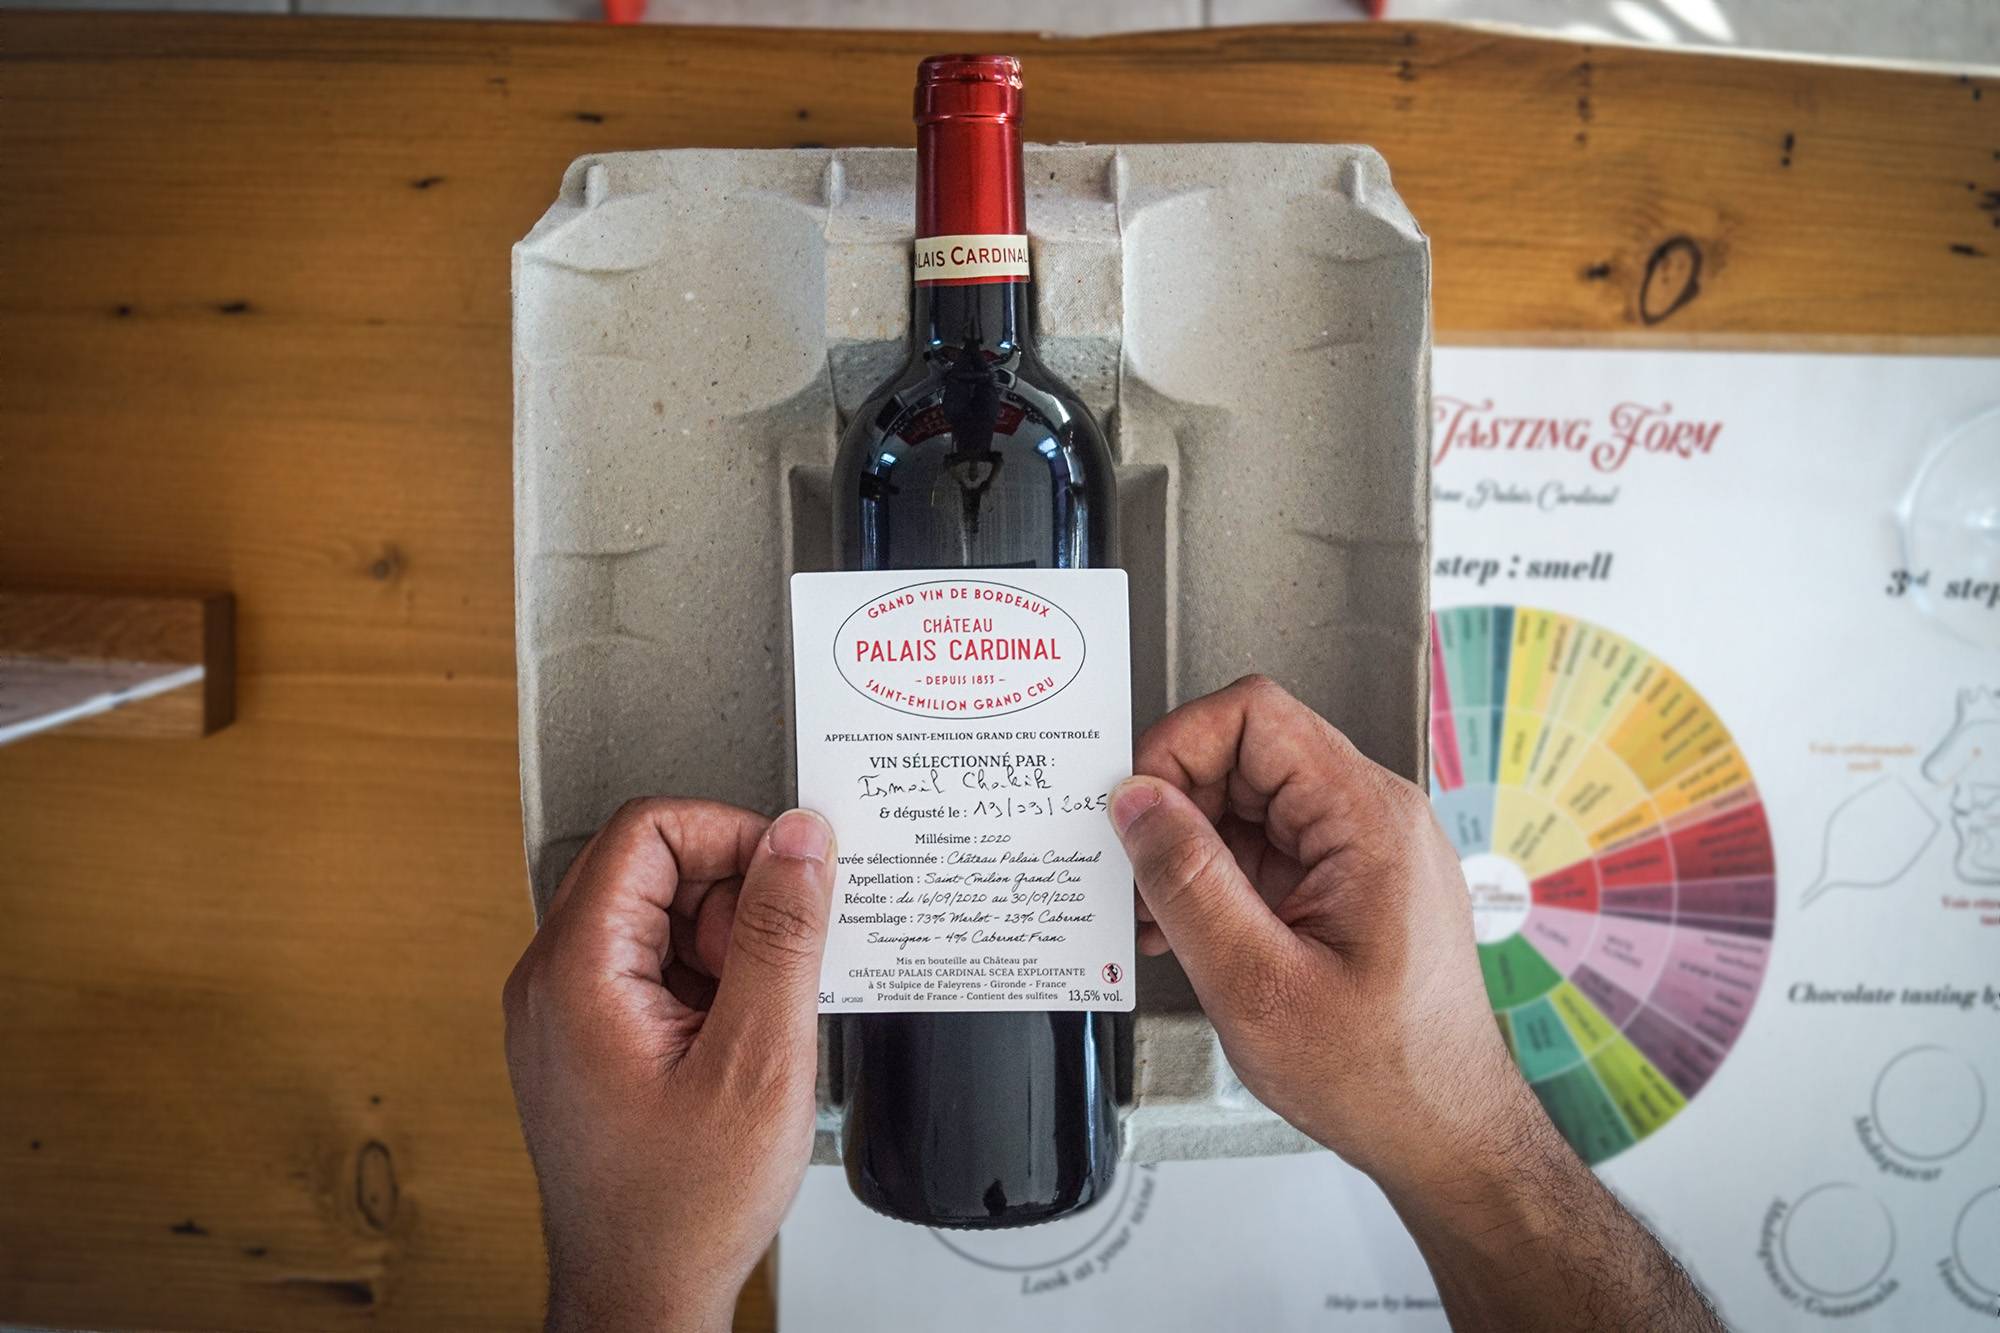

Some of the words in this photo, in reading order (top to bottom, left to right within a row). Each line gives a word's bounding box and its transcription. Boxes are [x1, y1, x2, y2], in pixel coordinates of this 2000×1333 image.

[1434, 554, 1500, 586] step
[1526, 552, 1614, 580] smell
[868, 594, 914, 617] GRAND
[920, 590, 942, 600] VIN
[951, 588, 967, 599] DE
[975, 587, 1052, 619] BORDEAUX
[924, 616, 992, 633] CHÂTEAU
[857, 640, 936, 662] PALAIS
[950, 639, 1061, 660] CARDINAL
[926, 676, 966, 685] DEPUIS
[972, 675, 994, 684] 1853
[865, 679, 966, 711] SAINT-EMILION
[974, 693, 1023, 712] GRAND
[1028, 678, 1055, 698] CRU
[976, 732, 1013, 740] GRAND
[1016, 731, 1035, 740] CRU
[1038, 728, 1100, 739] CONTROLÉE
[870, 757, 897, 768] VIN
[903, 752, 1012, 769] SÉLECTIONNÉ
[1016, 755, 1047, 767] PAR
[880, 807, 890, 818] &
[894, 806, 944, 821] dégusté
[949, 807, 959, 817] le
[915, 833, 970, 844] Millésime
[980, 835, 1011, 843] 2020
[838, 854, 864, 864] uvée
[867, 853, 937, 864] sélectionnée
[947, 851, 997, 864] Château
[1000, 852, 1039, 863] Palais
[1043, 850, 1101, 864] Cardinal
[848, 874, 913, 886] Appellation
[1012, 872, 1055, 895] Grand
[1055, 871, 1081, 883] Cru
[845, 893, 886, 904] Récolte
[896, 892, 913, 903] du
[918, 891, 987, 906] 16/09/2020
[1011, 891, 1085, 905] 30/09/2020
[838, 913, 907, 925] Assemblage
[917, 912, 946, 924] 73%
[950, 912, 992, 923] Merlot
[1005, 912, 1034, 923] 23%
[1038, 910, 1095, 923] Cabernet
[867, 932, 931, 950] Sauvignon
[946, 932, 968, 943] 4%
[972, 930, 1029, 943] Cabernet
[1027, 932, 1065, 942] Franc
[983, 956, 1019, 964] Château
[1023, 958, 1038, 966] par
[849, 968, 895, 977] CHÂTEAU
[899, 969, 932, 977] PALAIS
[989, 968, 1014, 976] SCEA
[1018, 968, 1085, 976] EXPLOITANTE
[868, 981, 874, 989] à
[877, 981, 885, 989] St
[889, 981, 921, 990] Sulpice
[938, 980, 981, 990] Faleyrens
[990, 980, 1026, 988] Gironde
[1036, 980, 1066, 988] France
[878, 993, 911, 1001] Produit
[967, 992, 1004, 1000] Contient
[1026, 992, 1058, 1000] sulfites
[1069, 990, 1100, 1002] 13,5%
[1103, 990, 1122, 1001] vol.
[1788, 981, 1895, 1005] Chocolate
[1901, 982, 1977, 1010] tasting
[1021, 1270, 1069, 1295] Look
